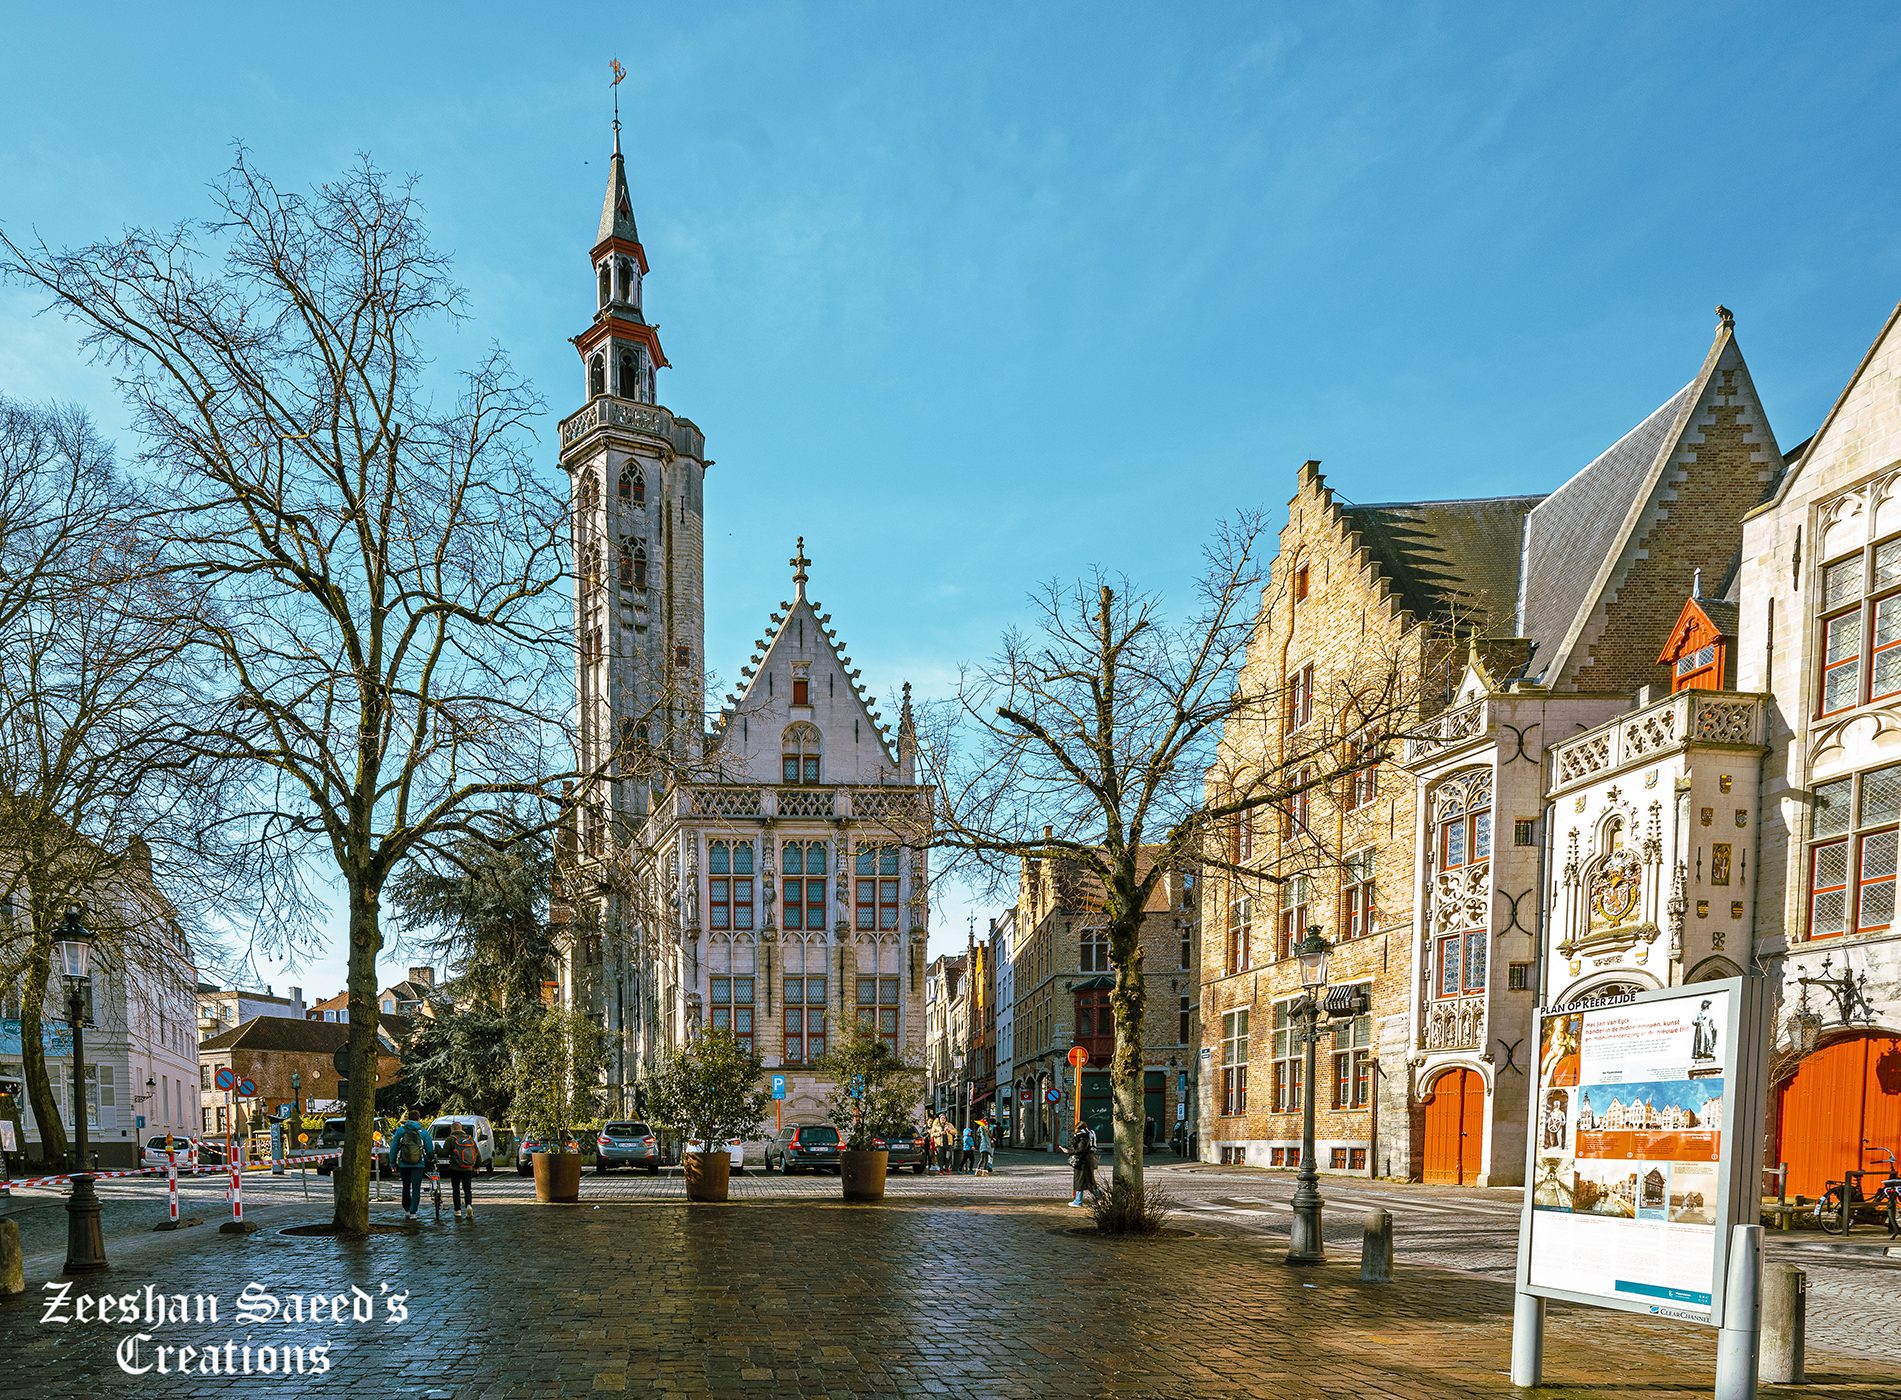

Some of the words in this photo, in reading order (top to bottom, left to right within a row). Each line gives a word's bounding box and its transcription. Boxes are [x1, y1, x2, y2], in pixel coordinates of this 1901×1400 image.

[1540, 1004, 1565, 1015] PLAN
[774, 1077, 783, 1091] P
[281, 1107, 289, 1117] P
